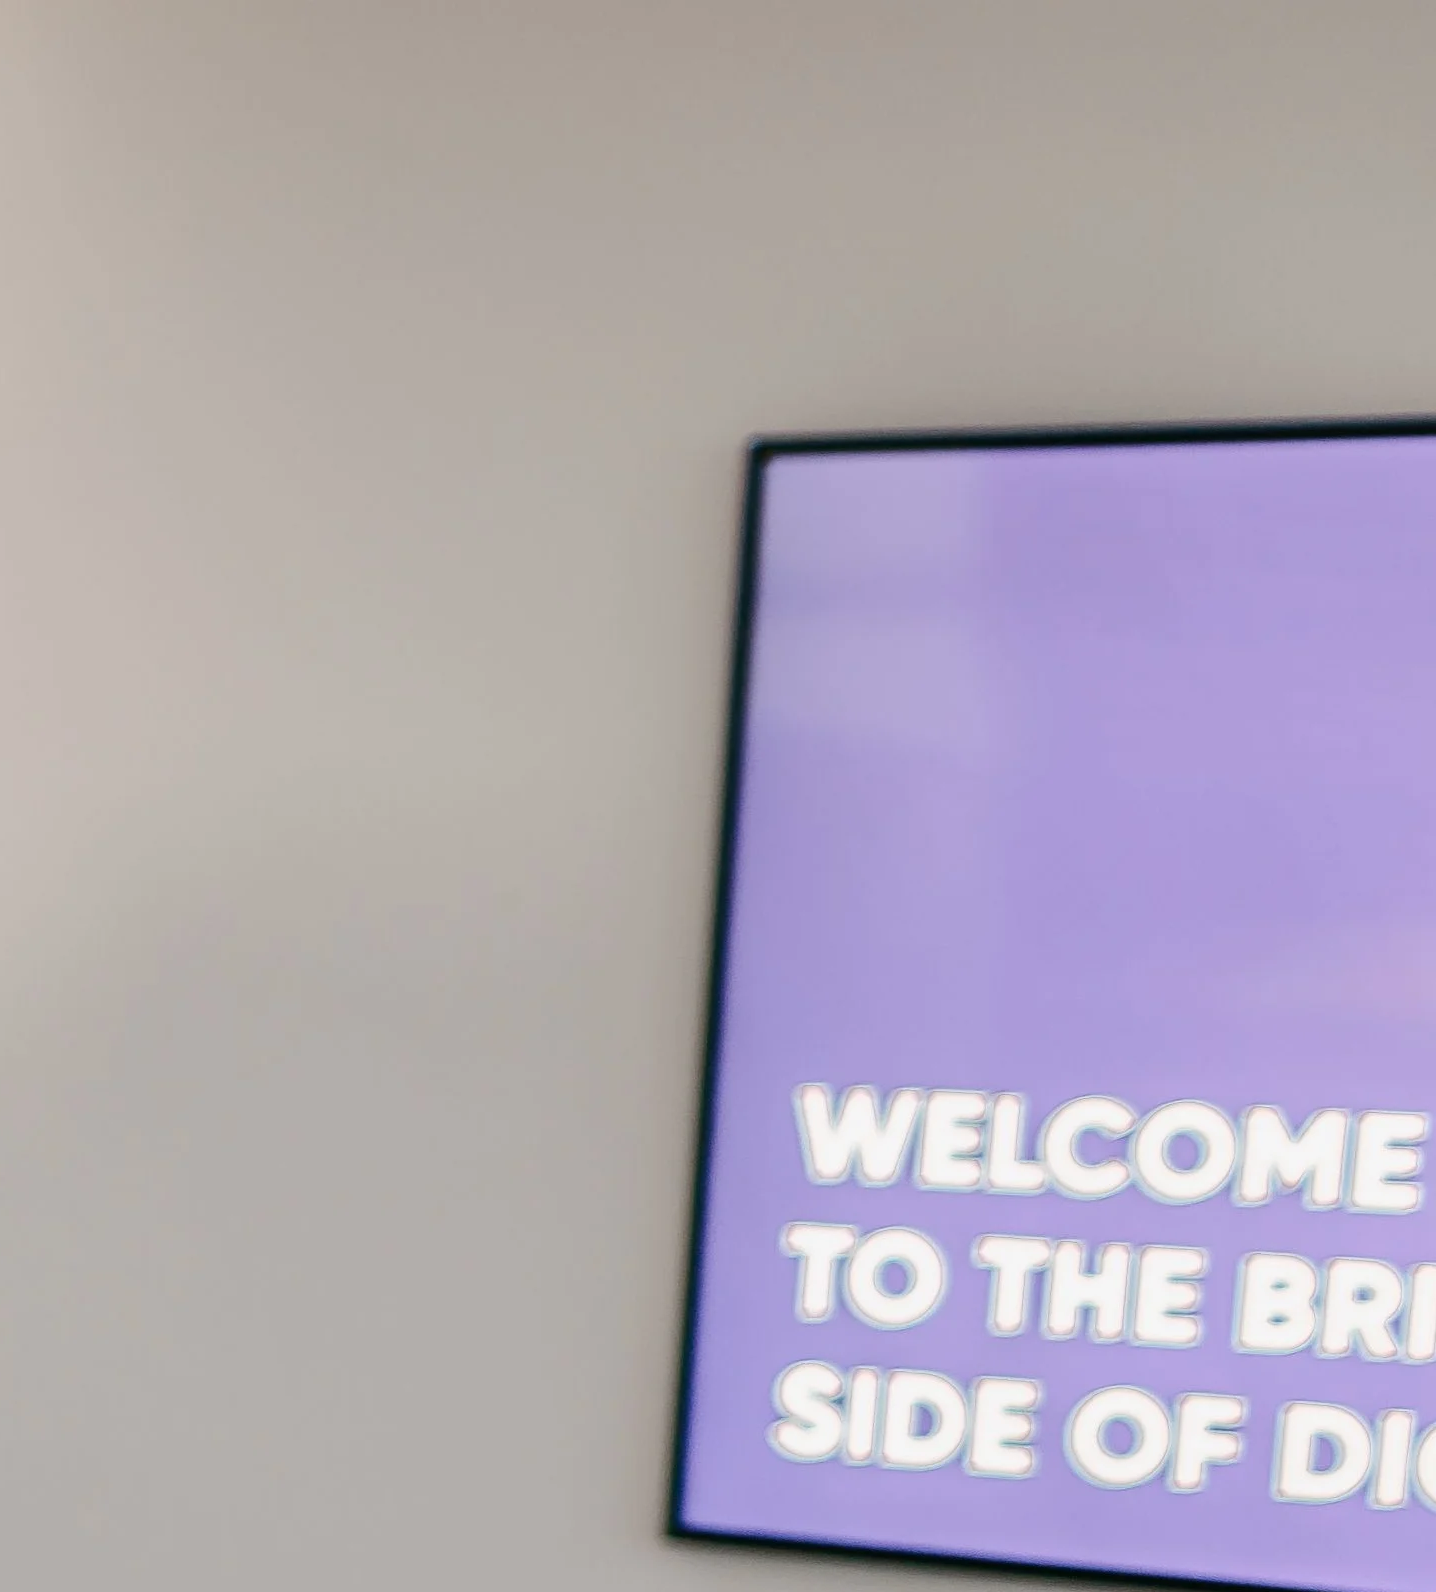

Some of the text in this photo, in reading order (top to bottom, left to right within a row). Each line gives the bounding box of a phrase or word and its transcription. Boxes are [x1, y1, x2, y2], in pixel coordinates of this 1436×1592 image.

[796, 1083, 1428, 1212] WELCOME
[785, 1223, 945, 1328] TO
[976, 1234, 1206, 1347] THE
[770, 1360, 1436, 1510] SIDE OF DI
